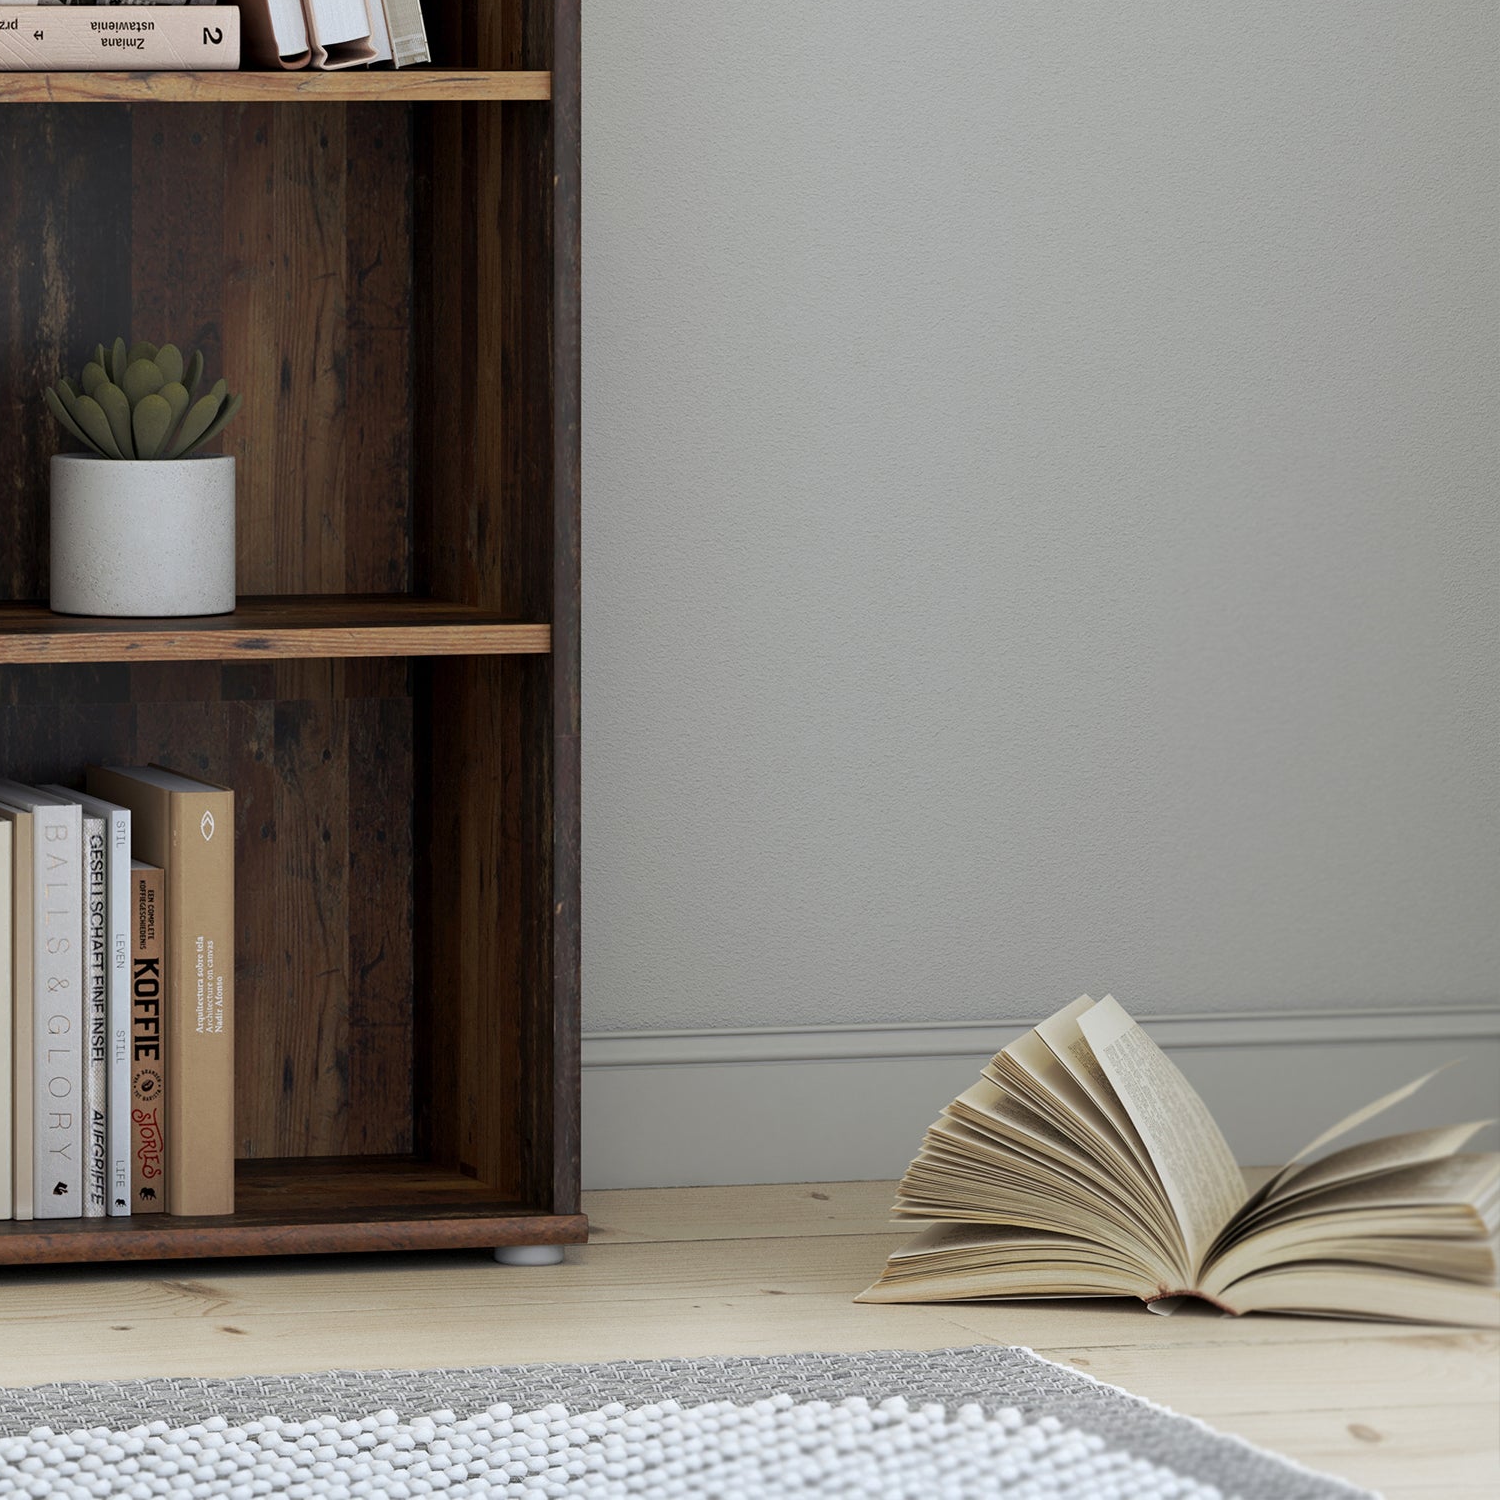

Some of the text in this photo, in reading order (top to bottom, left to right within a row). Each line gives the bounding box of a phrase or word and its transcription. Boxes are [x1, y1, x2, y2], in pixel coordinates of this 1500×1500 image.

[90, 21, 155, 33] ustawienia
[101, 38, 145, 49] Zmiana
[203, 27, 223, 45] 2
[90, 835, 104, 1067] GESELLSCHAFT EINE INSEL
[139, 880, 147, 950] KOFFIEGESCHIEDENIS
[147, 905, 155, 940] COMPLETE
[45, 825, 72, 1161] BALLS & GLORY
[116, 821, 126, 1187] STIL LEVEN STILL LIFE
[134, 957, 160, 1061] KOFFIE
[195, 936, 205, 1033] Arquitectura sobre tela
[206, 940, 214, 1033] Architecture on canvas
[215, 976, 223, 1033] Nadir Afonso
[132, 1107, 164, 1179] STORIES
